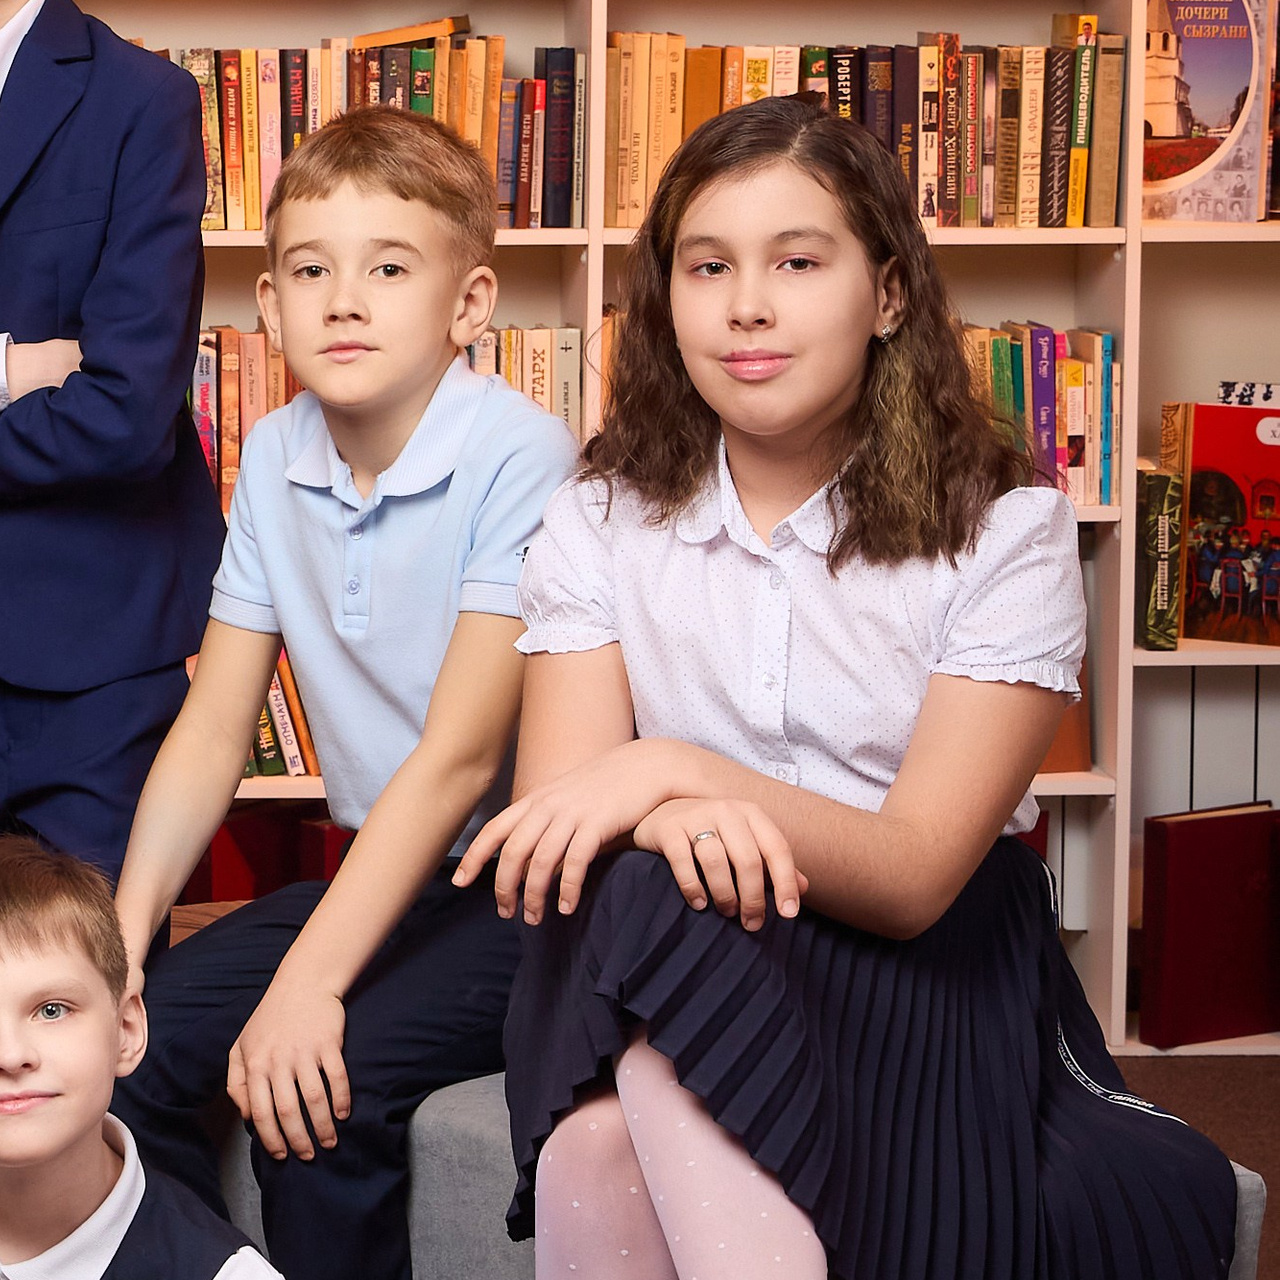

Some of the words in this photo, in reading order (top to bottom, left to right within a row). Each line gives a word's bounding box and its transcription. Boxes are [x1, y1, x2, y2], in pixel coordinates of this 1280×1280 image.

[1176, 6, 1229, 21] ДОЧЕРИ
[1183, 24, 1249, 39] СЫЗРАНИ
[290, 69, 303, 117] ШАНСЫ
[836, 59, 850, 103] РОБЕРТ
[965, 56, 976, 121] ЛИХОРАДКА
[1077, 48, 1091, 145] ПИЩЕВОДИТЕЛЬ
[226, 87, 236, 120] ЗВЕЗДАМ
[523, 114, 532, 139] ТОСТЫ
[520, 142, 531, 183] АВАРСКИЕ
[965, 124, 976, 173] ЗОЛОТАЯ
